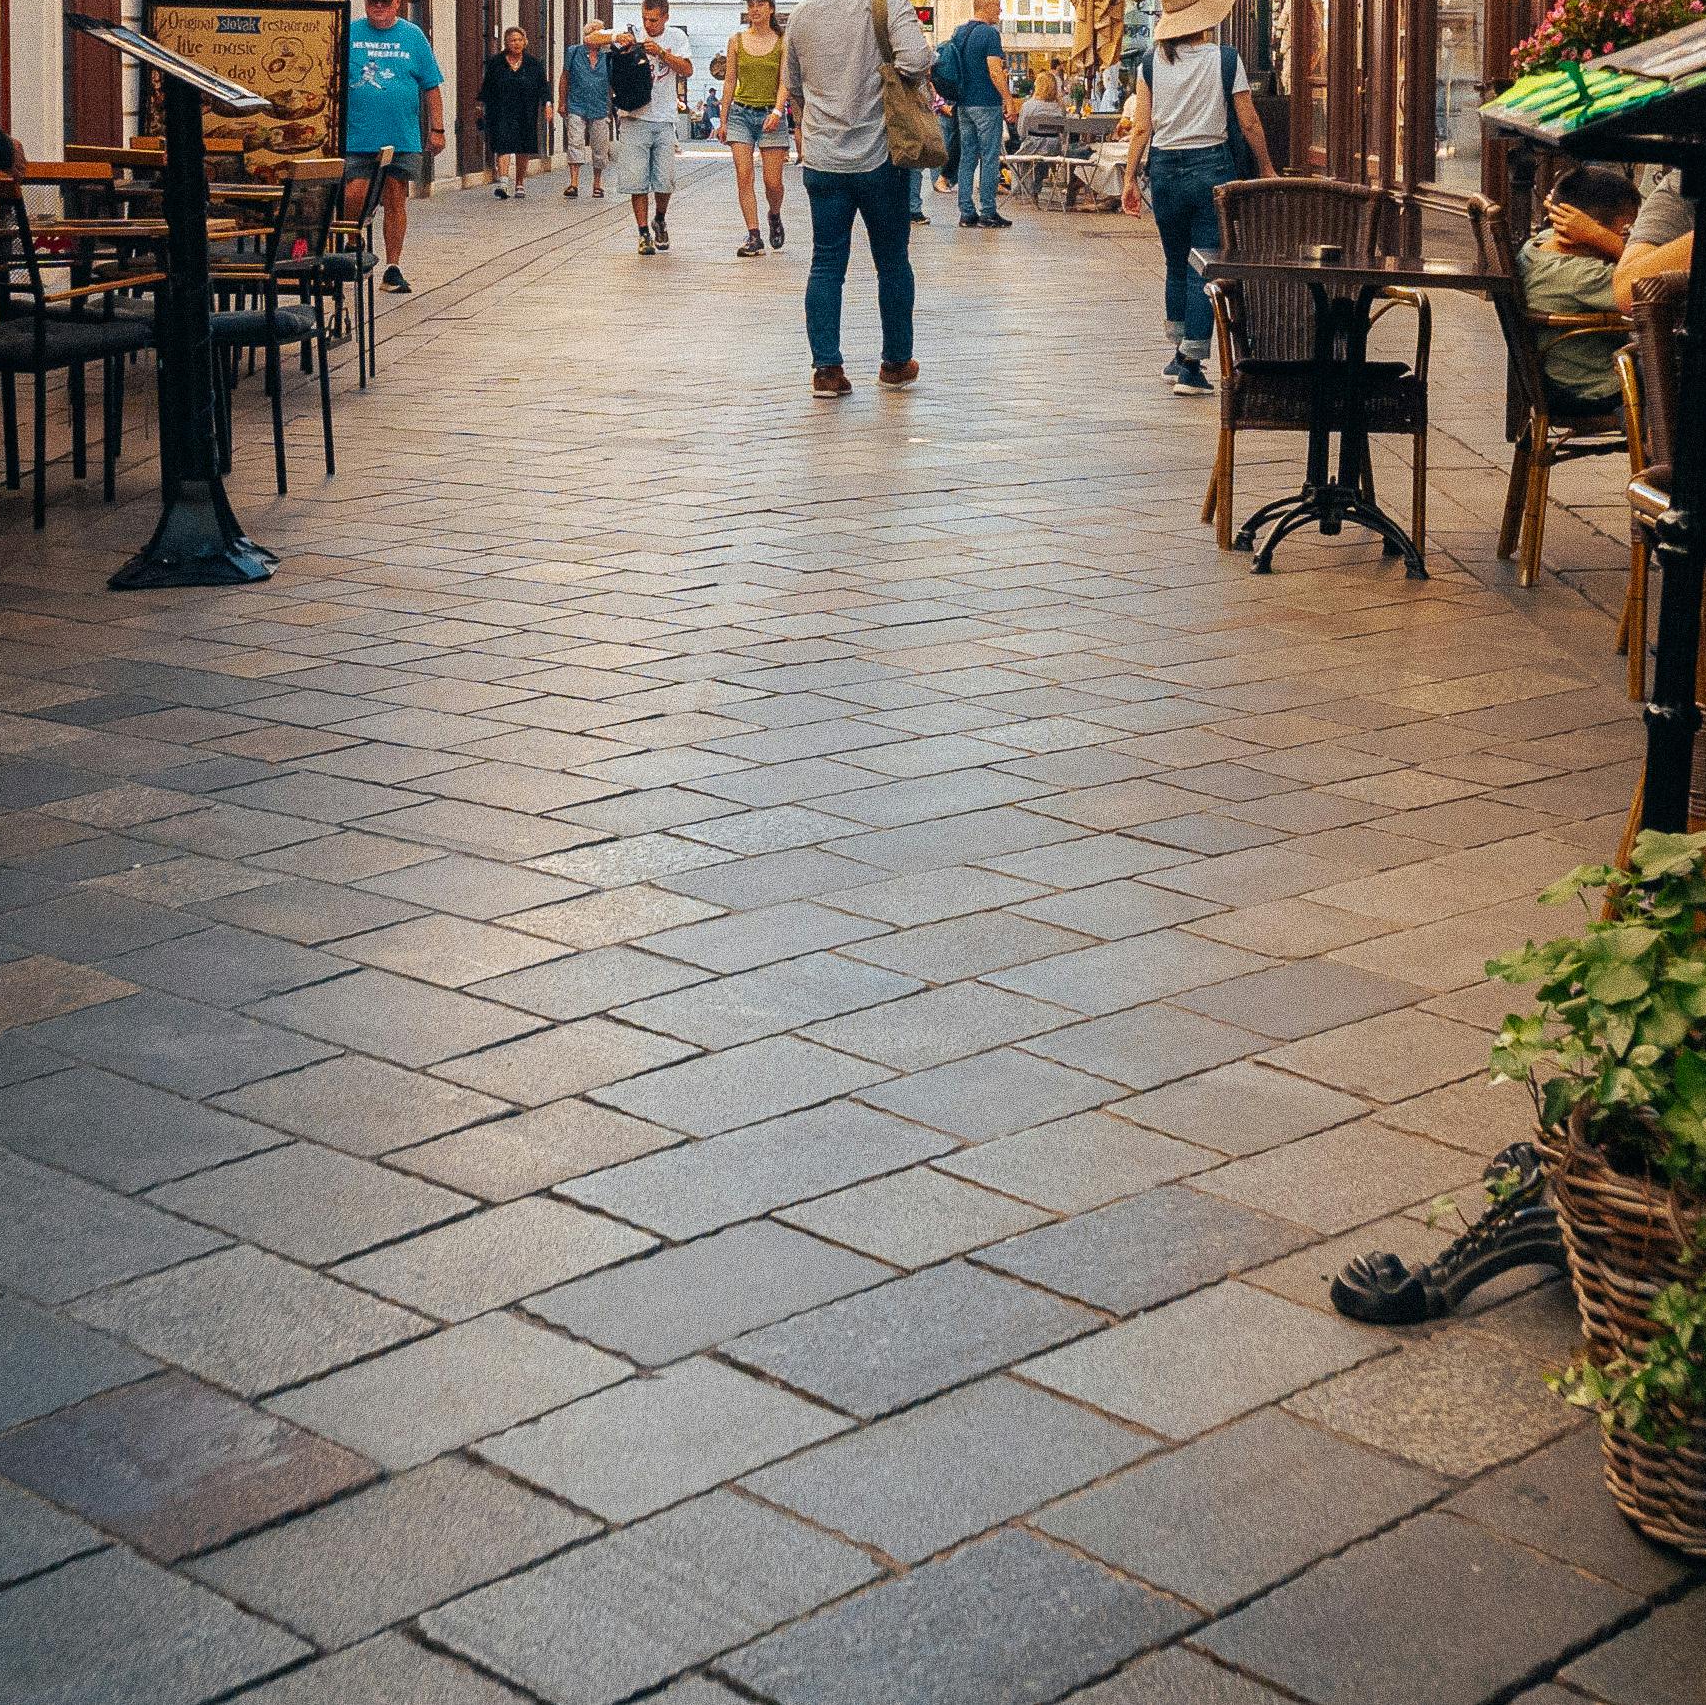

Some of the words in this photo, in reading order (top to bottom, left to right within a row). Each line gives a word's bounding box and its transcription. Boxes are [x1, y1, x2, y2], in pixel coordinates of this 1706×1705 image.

[168, 10, 214, 31] Original
[220, 16, 258, 32] slovak
[227, 64, 257, 84] day
